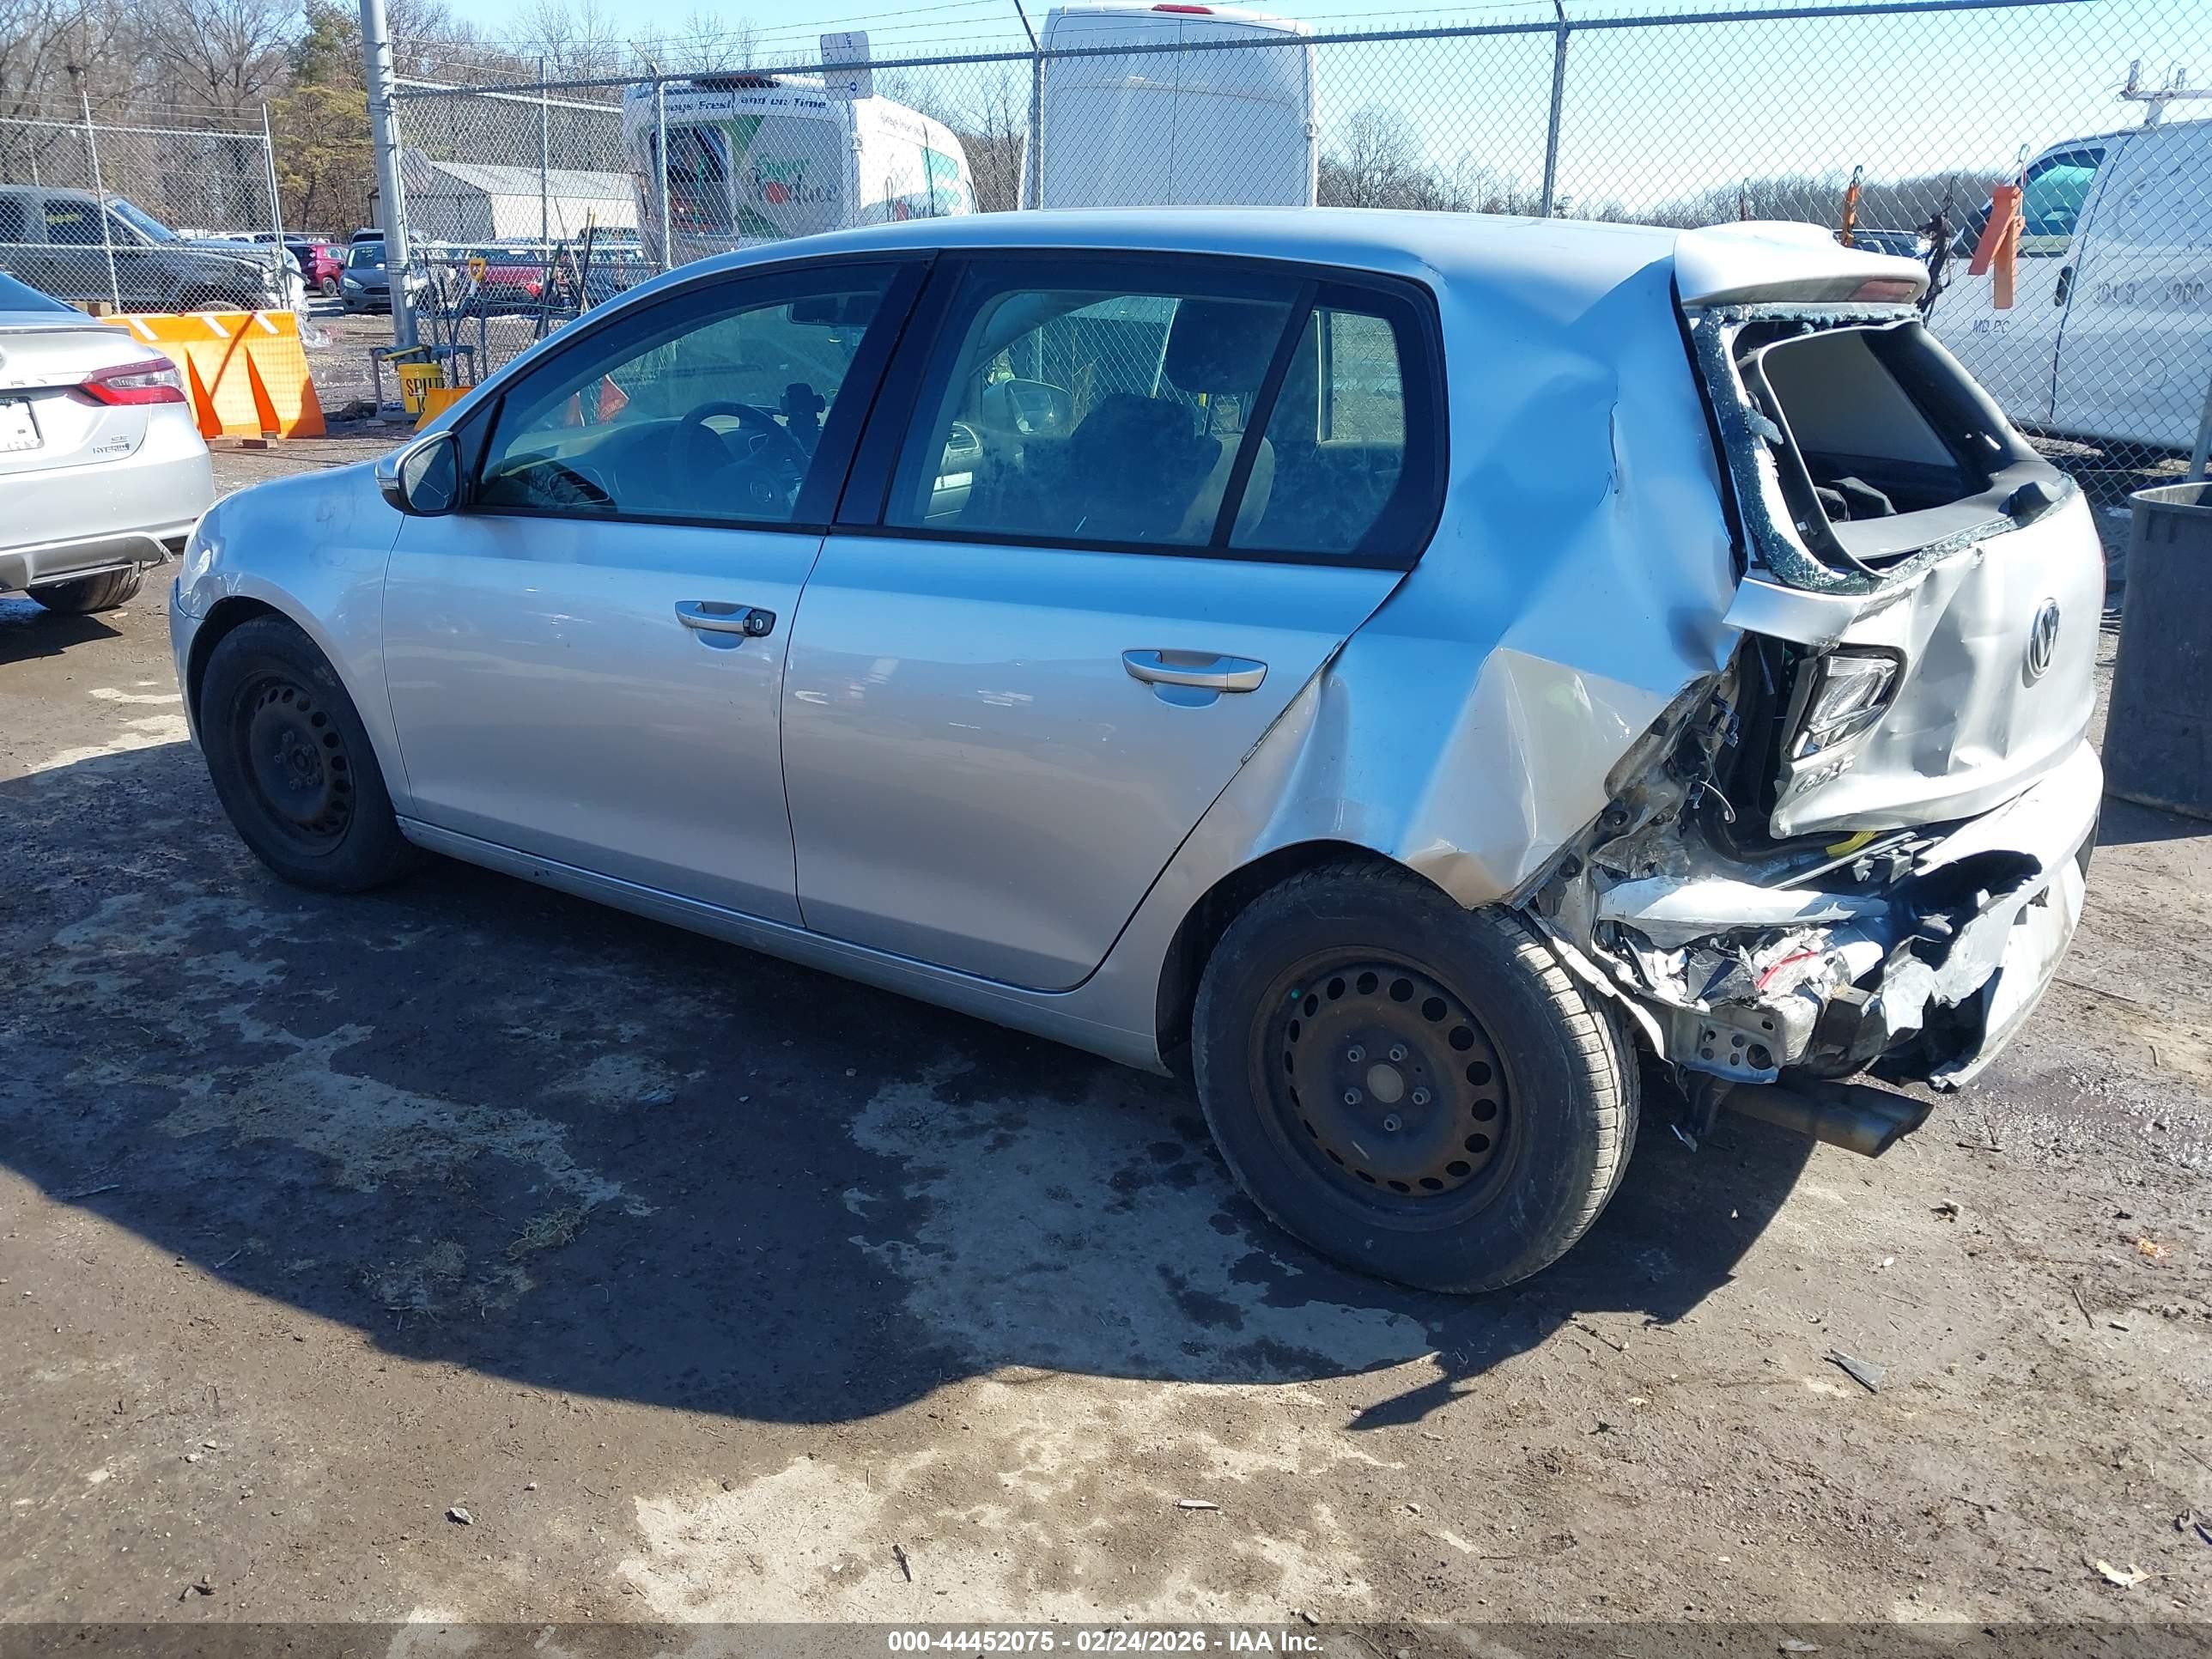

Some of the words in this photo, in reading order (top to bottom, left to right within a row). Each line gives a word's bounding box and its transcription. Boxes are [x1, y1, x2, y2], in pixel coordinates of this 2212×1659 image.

[698, 100, 734, 111] Fresh
[740, 95, 766, 105] and
[793, 97, 827, 109] Time
